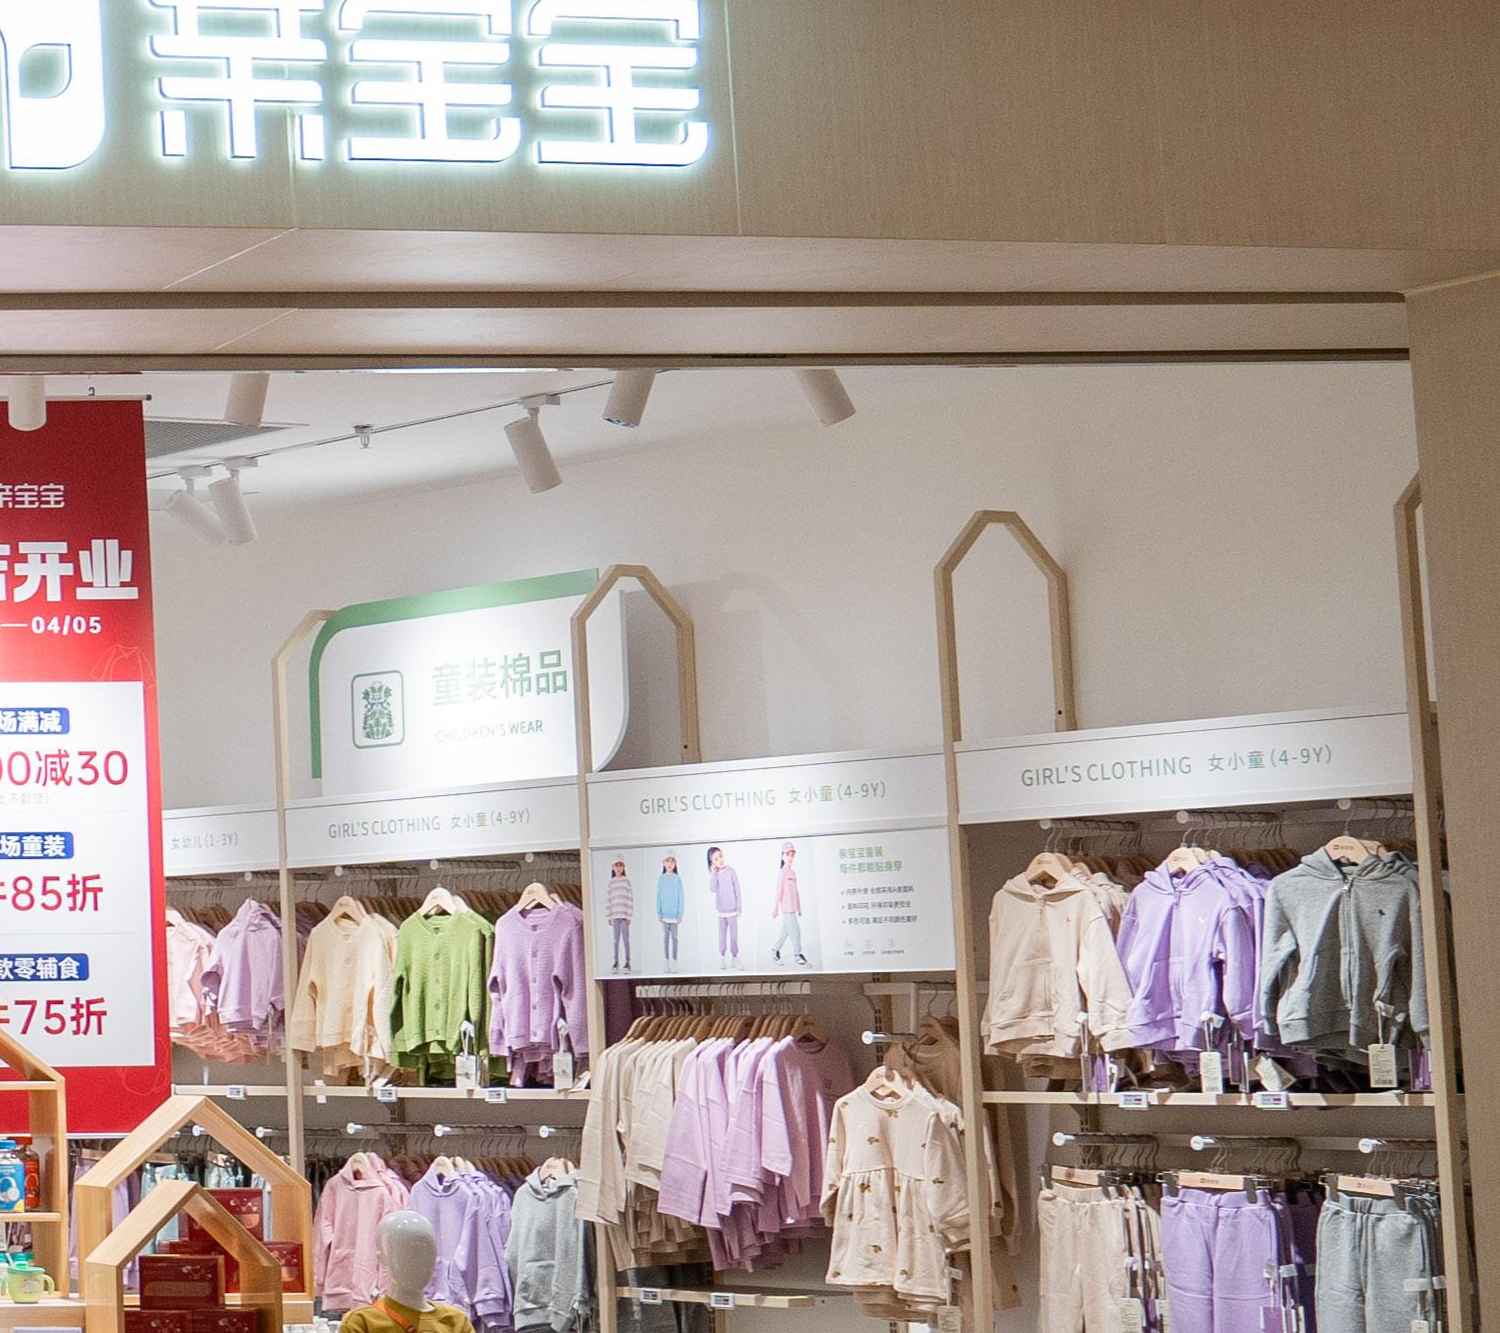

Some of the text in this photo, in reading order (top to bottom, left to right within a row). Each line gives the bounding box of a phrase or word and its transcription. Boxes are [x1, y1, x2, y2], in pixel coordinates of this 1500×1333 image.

[431, 647, 570, 708] 童装棉品
[435, 718, 545, 744] CHILDREN'S WEAR
[1020, 764, 1083, 788] GIRL'S
[1086, 755, 1194, 783] CLOTHING
[638, 794, 690, 816] GIRL'S
[692, 788, 778, 812] CLOTHING
[327, 817, 370, 841] GIRL'S
[370, 814, 442, 838] CLOTHING
